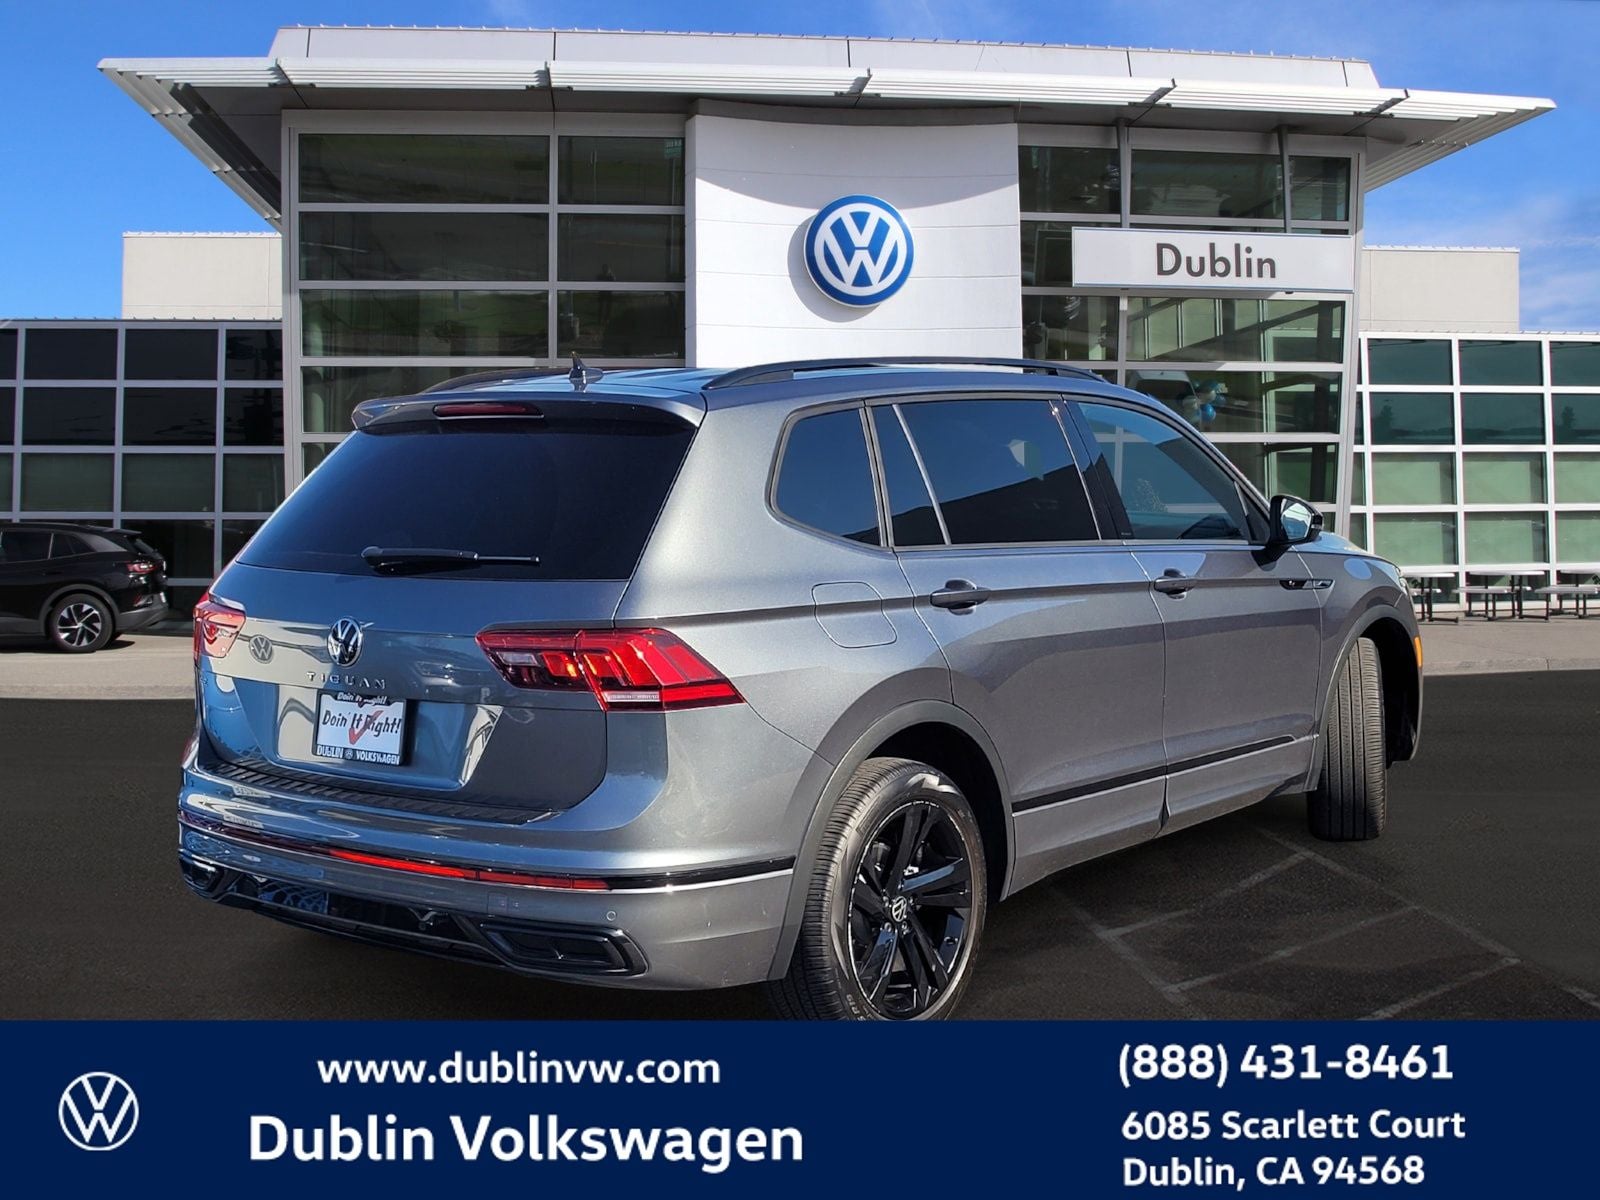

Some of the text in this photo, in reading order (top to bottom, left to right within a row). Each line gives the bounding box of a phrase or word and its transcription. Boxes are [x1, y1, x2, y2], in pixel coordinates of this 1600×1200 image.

[1156, 242, 1277, 279] Dublin
[306, 672, 386, 690] TIGUAN
[322, 709, 402, 738] Doin' It Right!
[317, 745, 344, 759] DUBLIN
[356, 750, 400, 766] VOLKSWAGEN
